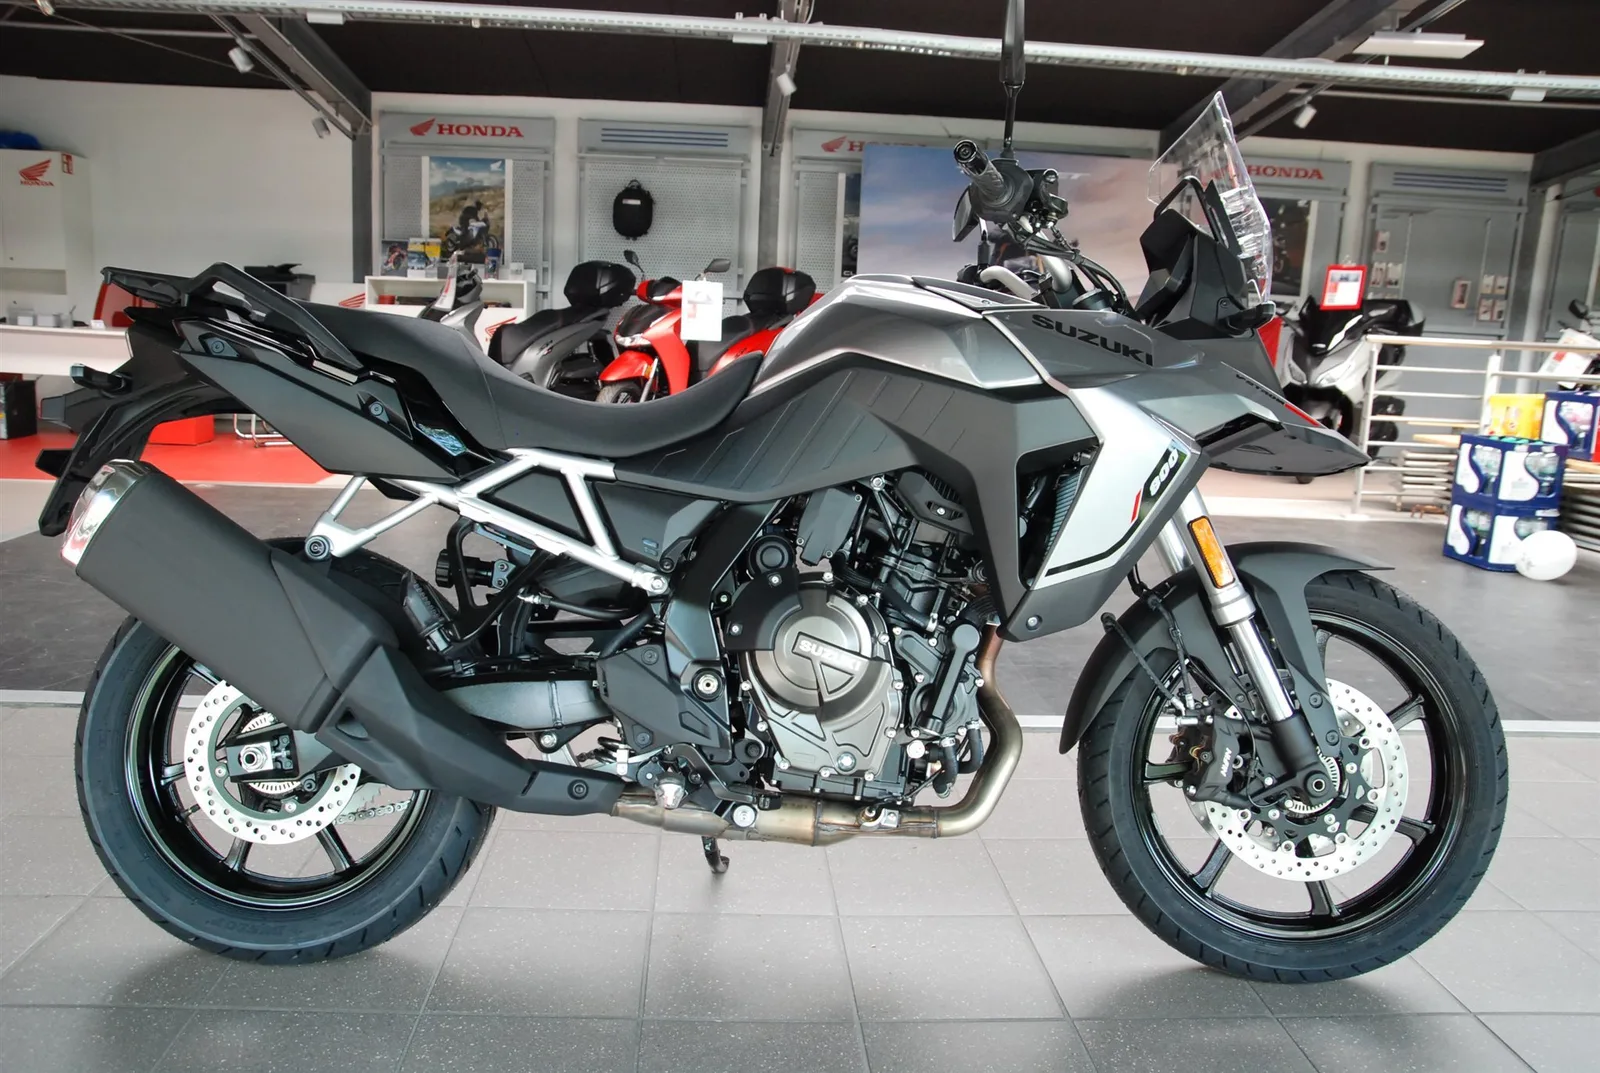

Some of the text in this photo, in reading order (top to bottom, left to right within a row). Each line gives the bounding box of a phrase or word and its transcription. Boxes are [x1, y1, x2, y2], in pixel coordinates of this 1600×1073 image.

[437, 123, 524, 138] HONDA
[1247, 164, 1324, 180] HONDA
[1031, 314, 1153, 367] SUZUKI
[1149, 448, 1179, 497] 800
